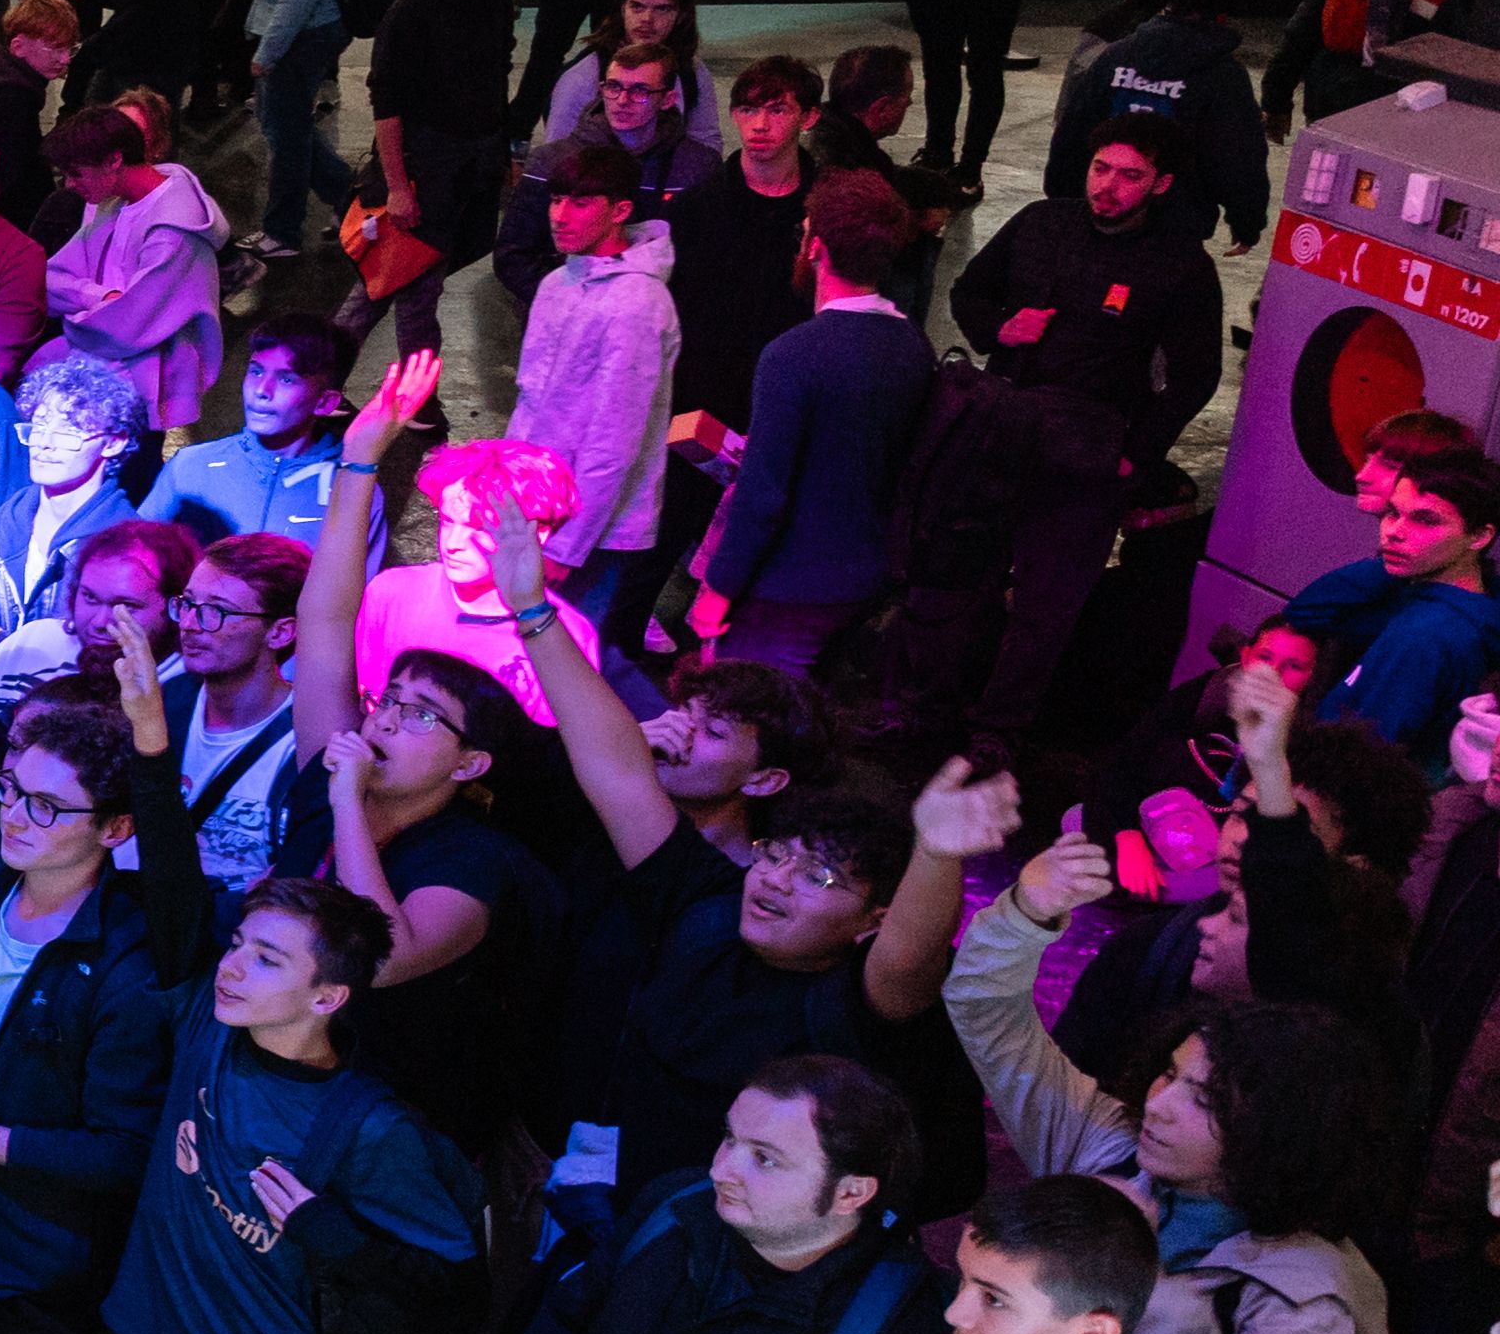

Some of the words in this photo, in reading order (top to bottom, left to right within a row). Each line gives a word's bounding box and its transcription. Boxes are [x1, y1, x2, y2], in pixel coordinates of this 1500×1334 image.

[1110, 67, 1187, 99] Heart
[1453, 305, 1490, 330] 1207
[205, 1185, 280, 1254] otify
